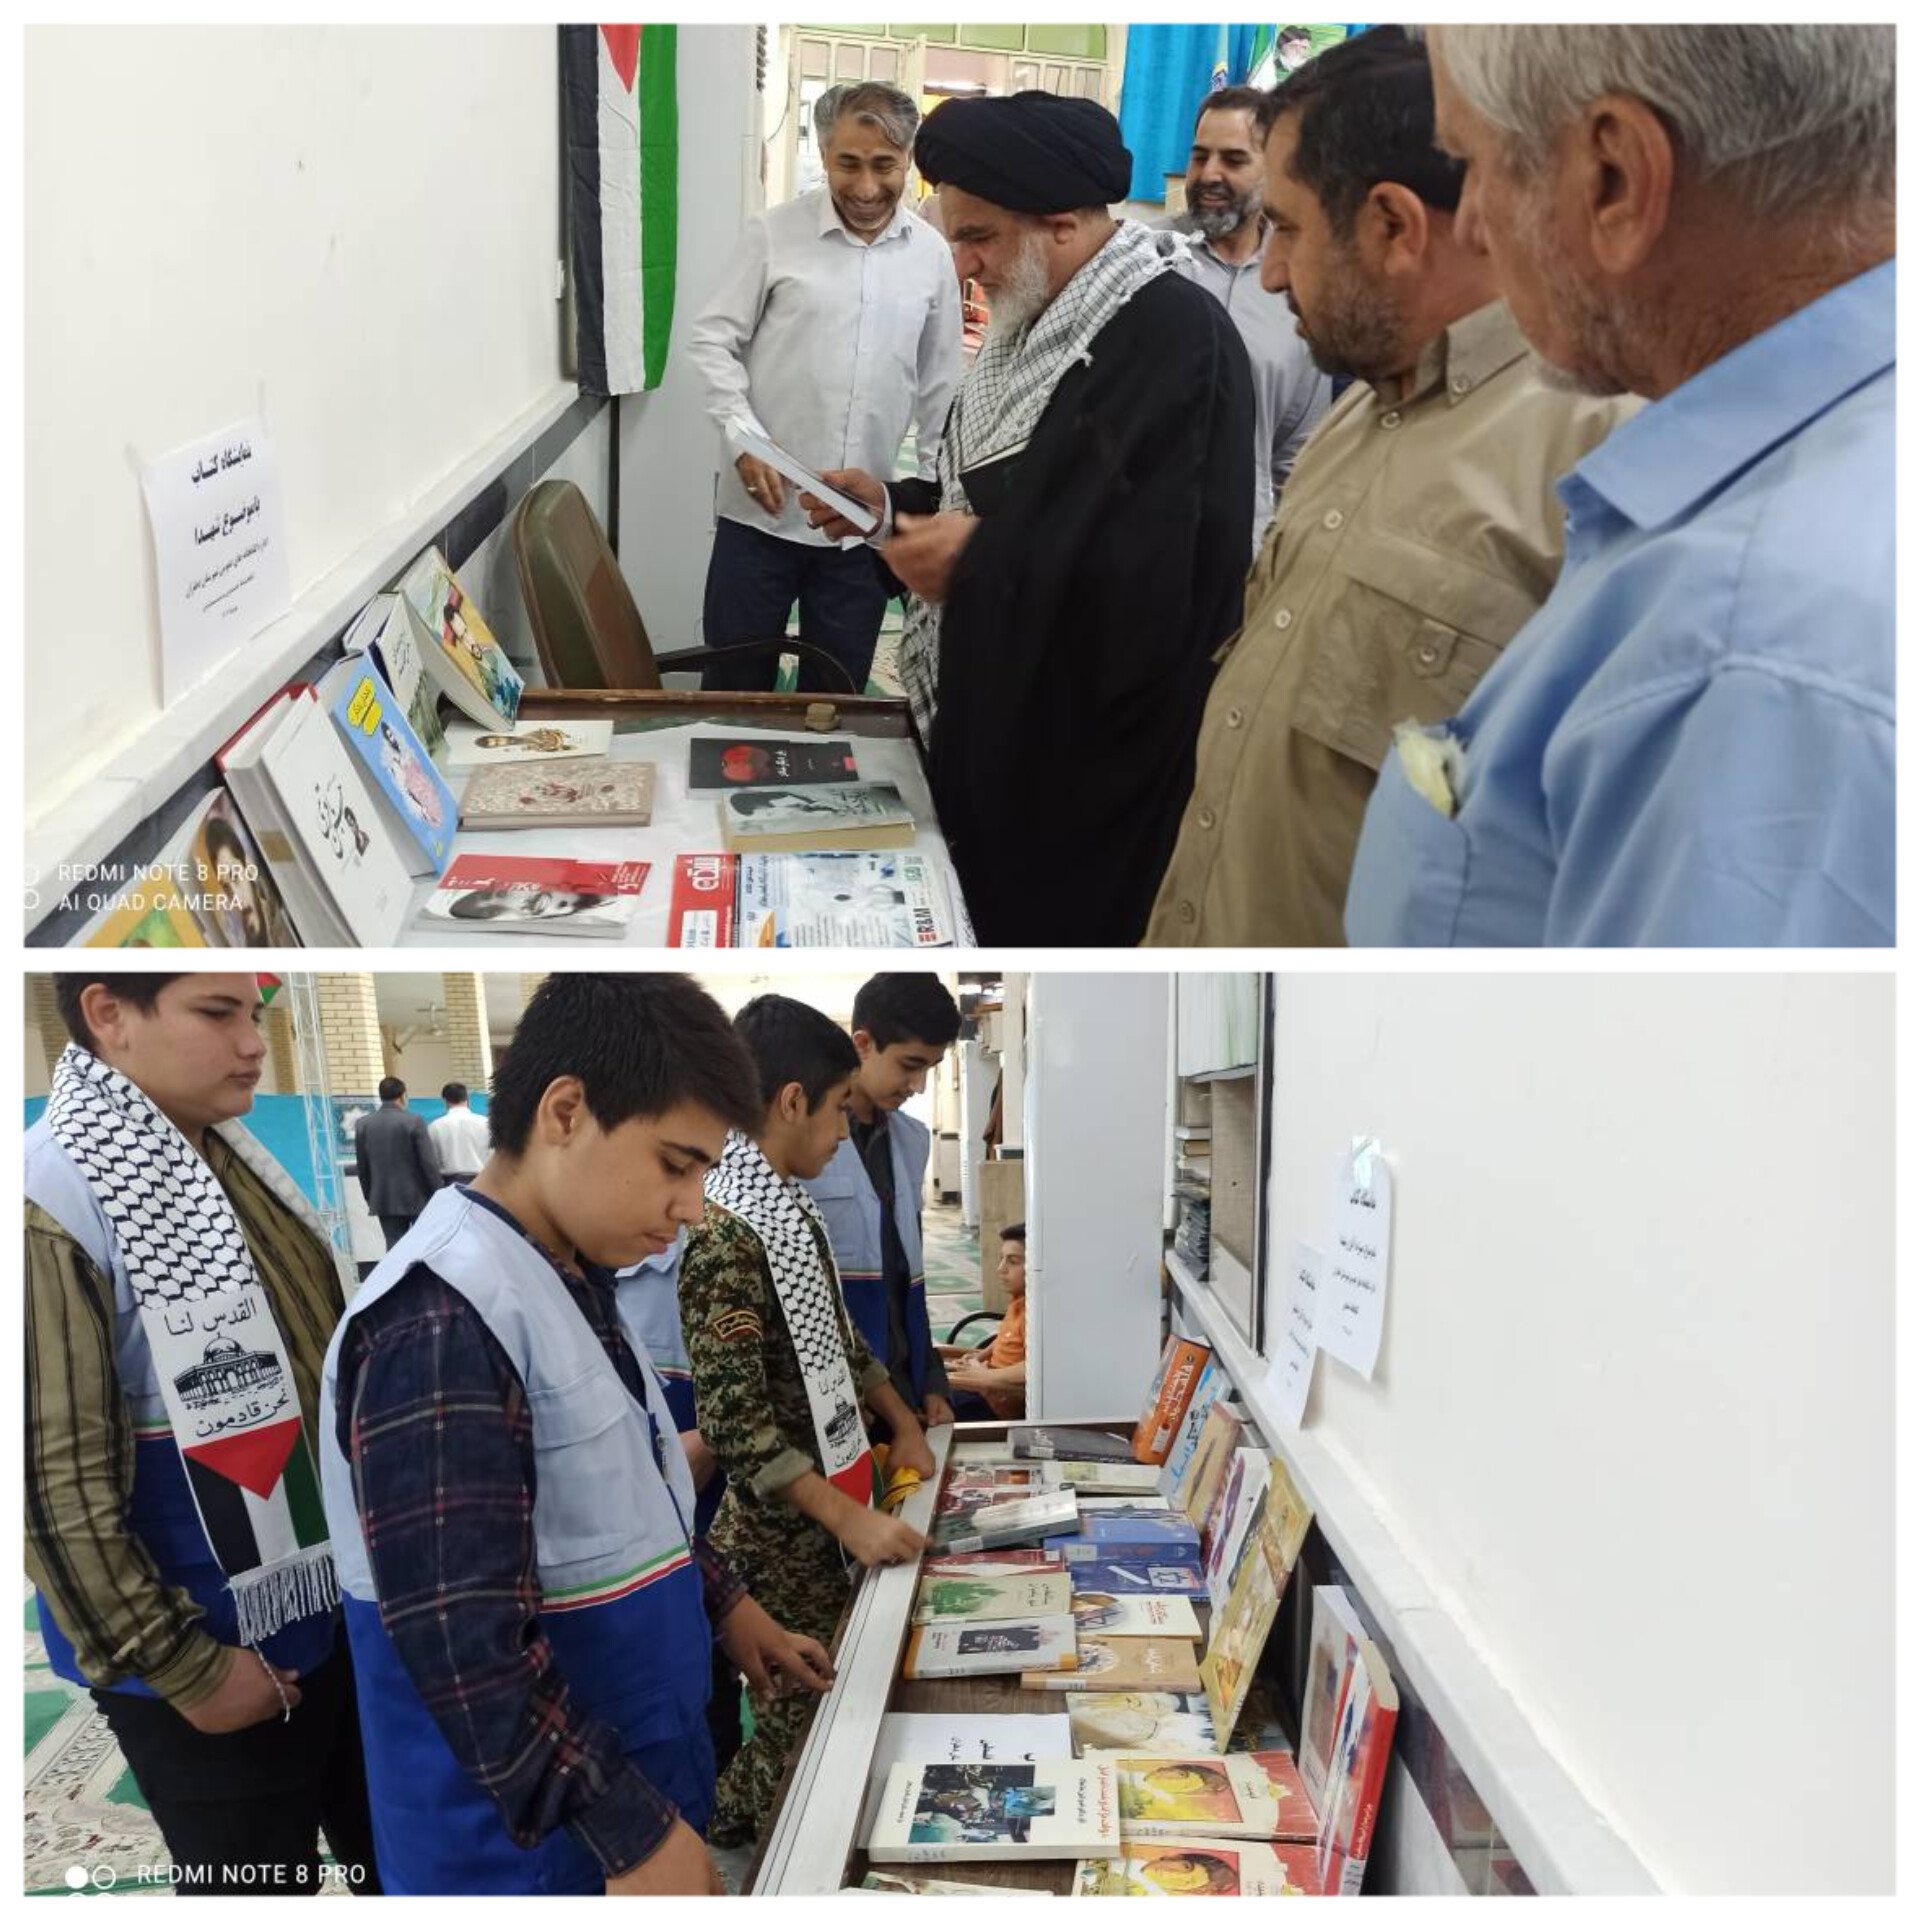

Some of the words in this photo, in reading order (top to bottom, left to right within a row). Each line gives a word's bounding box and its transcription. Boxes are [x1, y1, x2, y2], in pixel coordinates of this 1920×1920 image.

[191, 453, 219, 488] کتاب
[164, 1311, 194, 1335] لنا
[202, 1297, 257, 1332] القدس
[197, 1401, 261, 1437] قادمون
